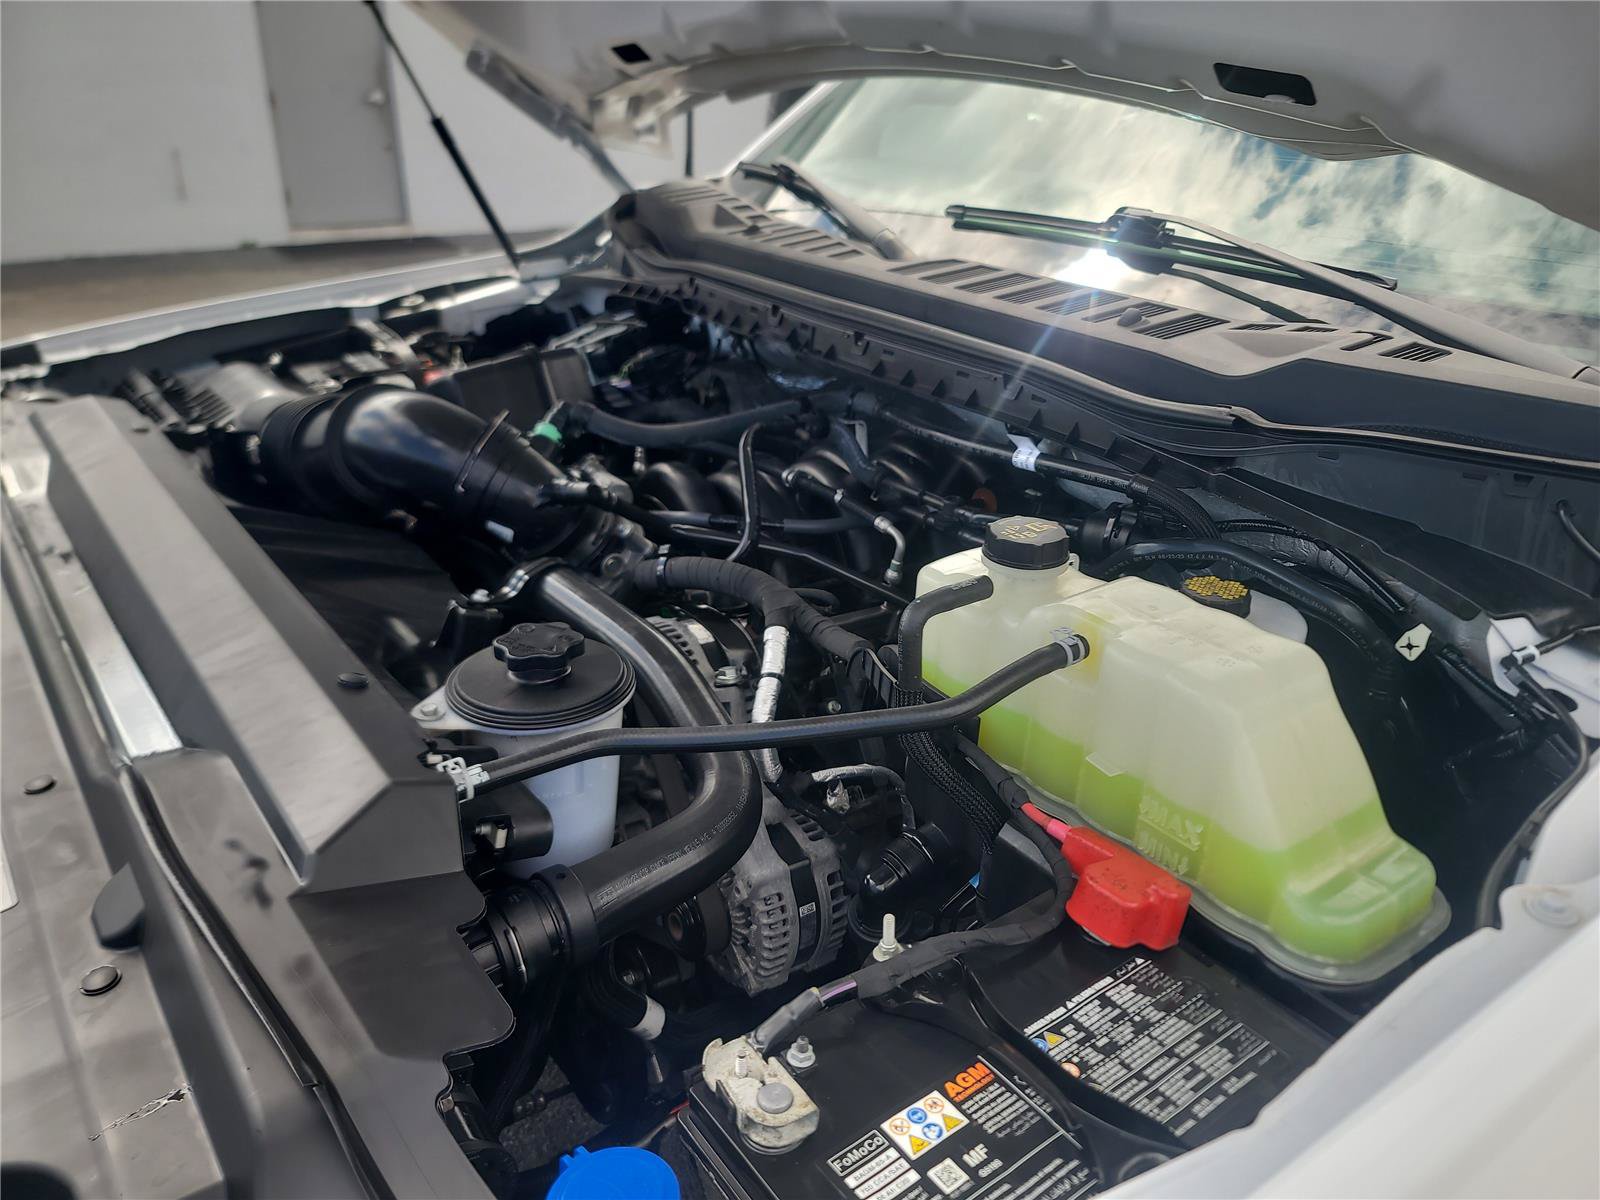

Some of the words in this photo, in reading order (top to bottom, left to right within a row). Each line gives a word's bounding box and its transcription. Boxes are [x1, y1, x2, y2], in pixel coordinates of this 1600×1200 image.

[1147, 798, 1203, 846] MAX
[944, 1061, 991, 1098] AGM
[832, 1136, 884, 1172] FoMoCo
[962, 1143, 988, 1168] MF
